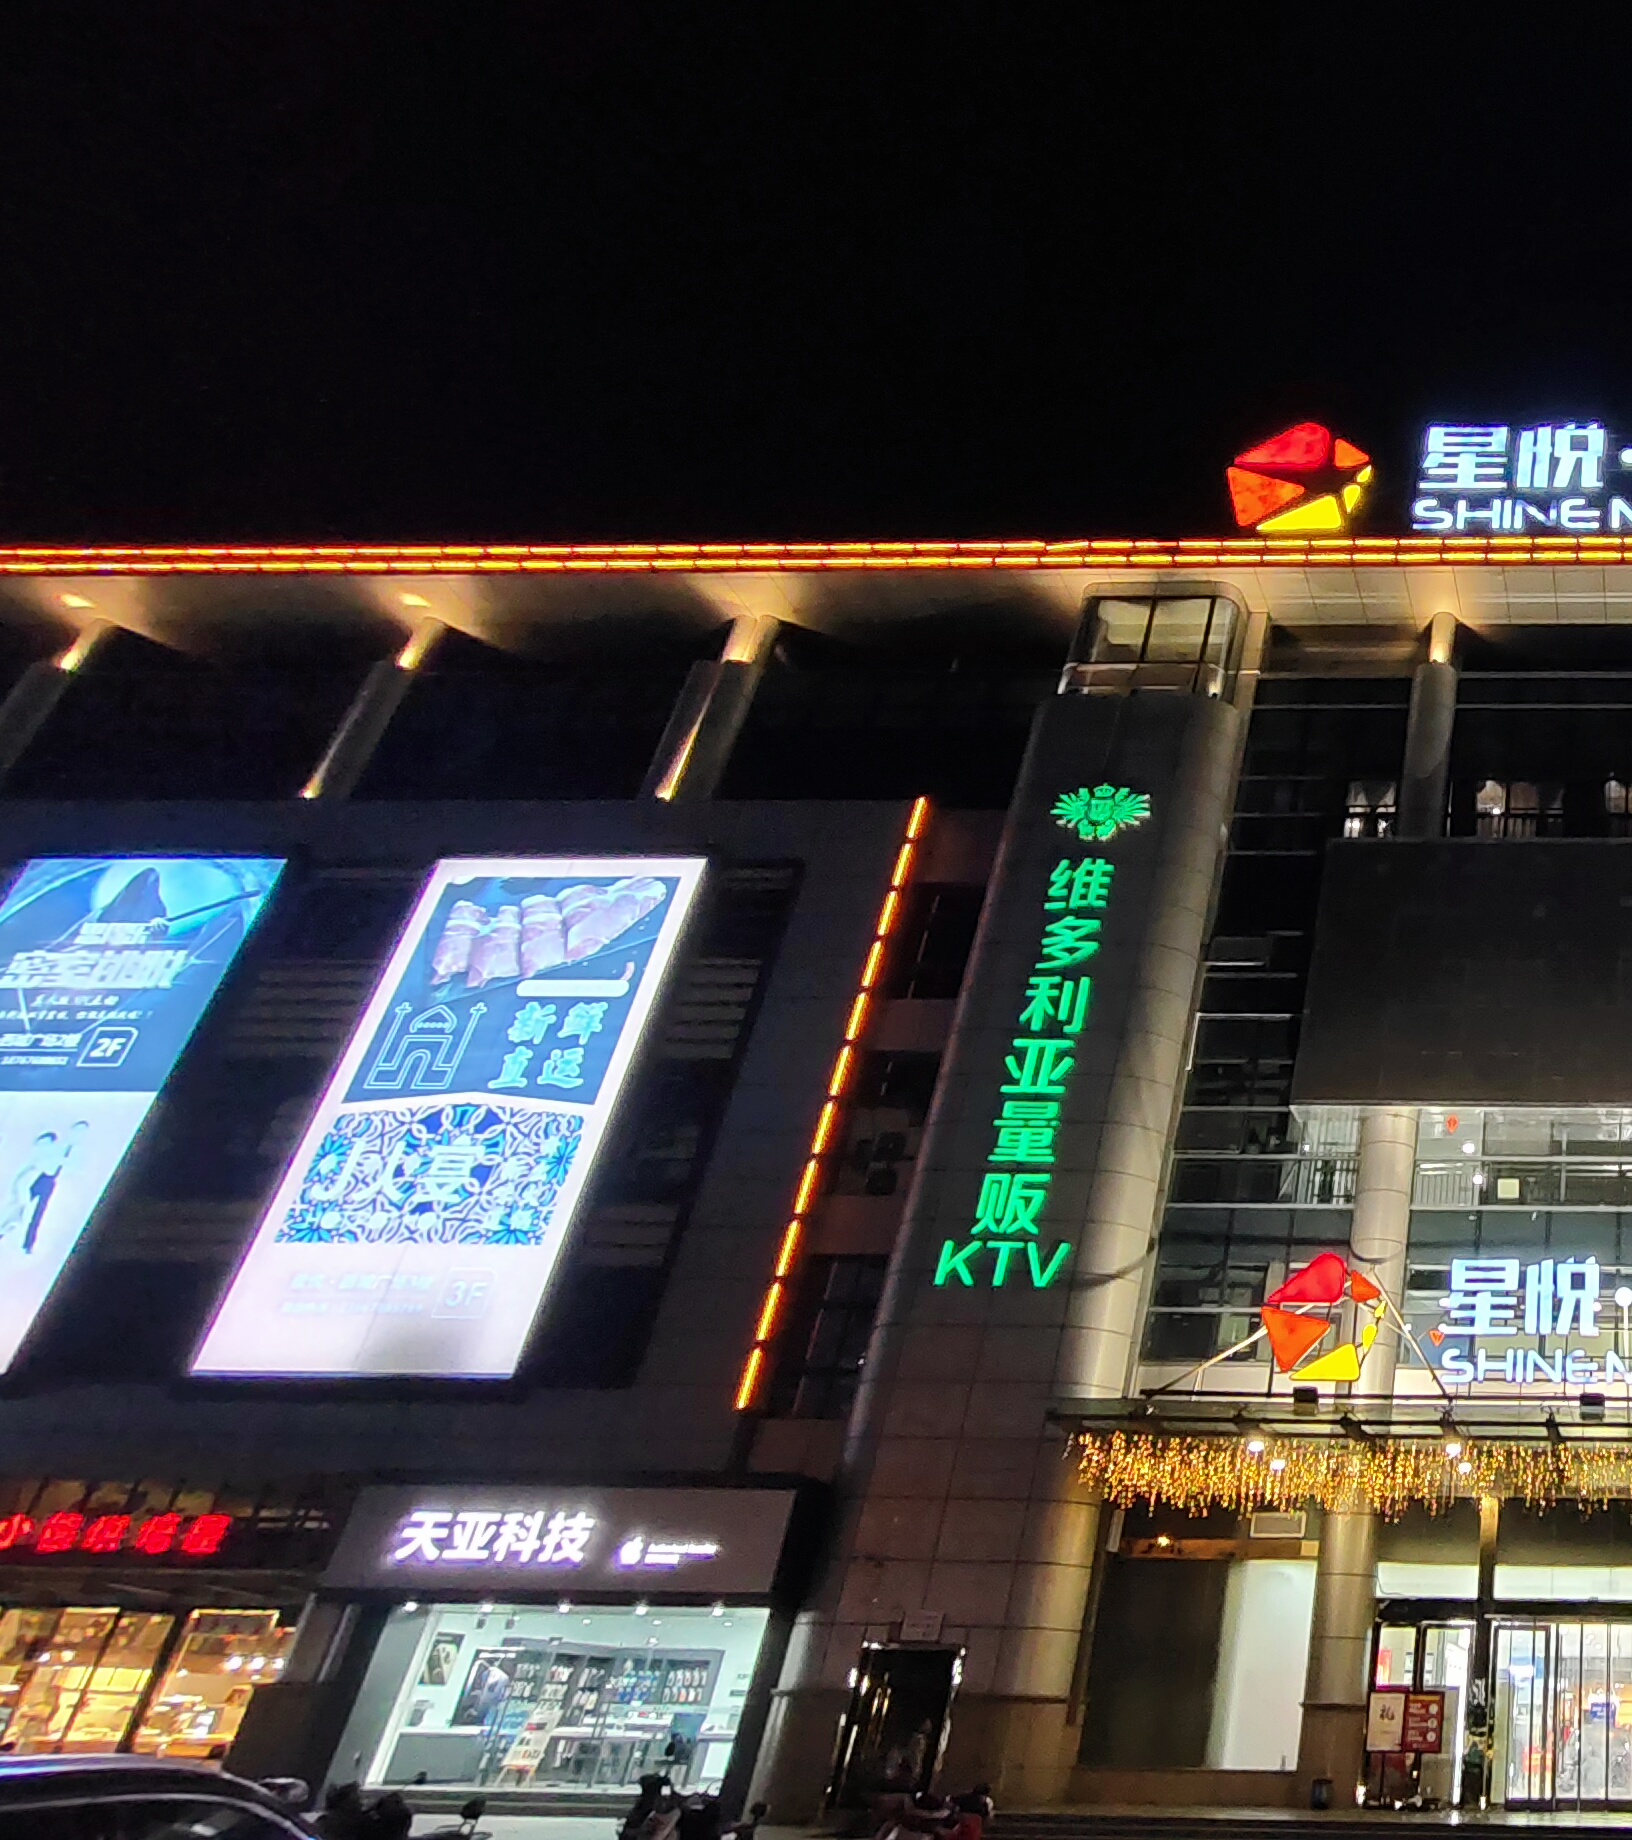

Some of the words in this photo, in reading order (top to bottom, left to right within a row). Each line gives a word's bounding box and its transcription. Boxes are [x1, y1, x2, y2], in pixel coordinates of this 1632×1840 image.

[89, 1037, 127, 1058] 2F
[971, 857, 1115, 1235] 维多利亚量贩
[934, 1240, 1072, 1289] KTV
[445, 1280, 489, 1308] 3F
[394, 1510, 597, 1563] 天亚科技
